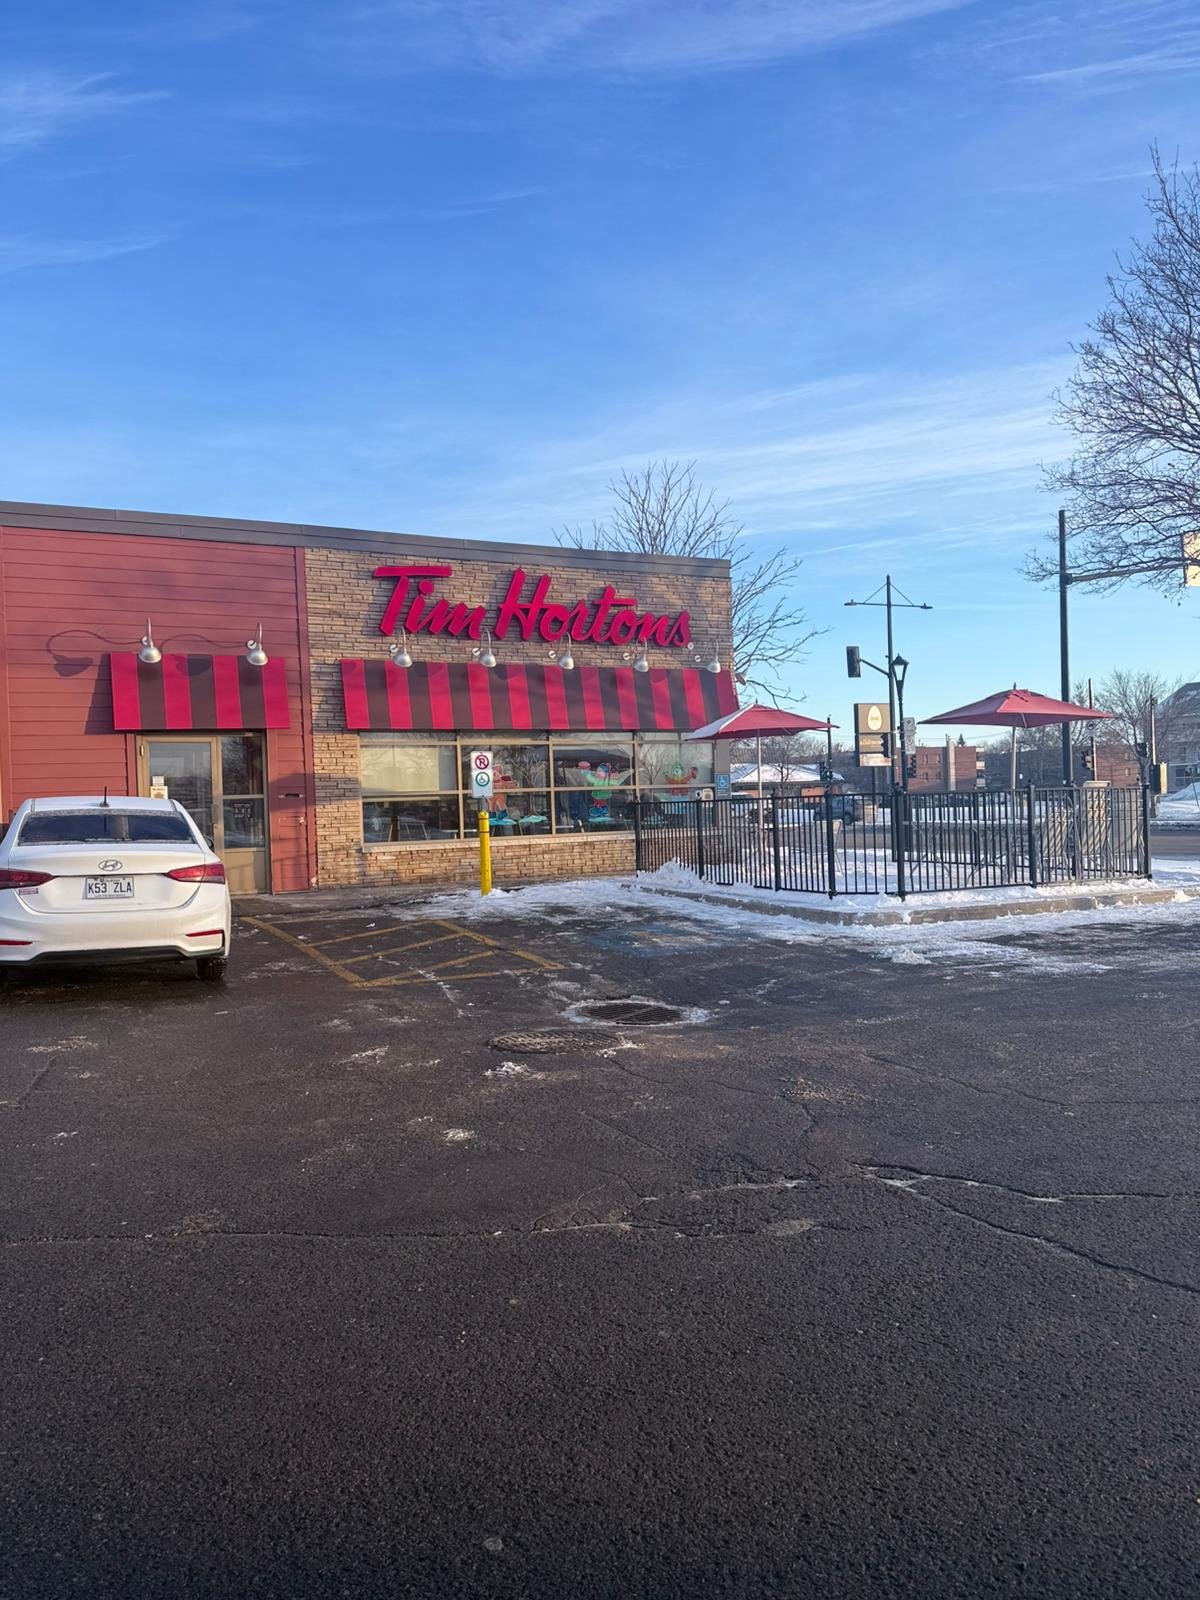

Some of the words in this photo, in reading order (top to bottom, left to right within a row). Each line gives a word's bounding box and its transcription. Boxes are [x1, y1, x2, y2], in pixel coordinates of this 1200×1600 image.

[373, 566, 486, 639] Tim
[494, 567, 692, 648] Hortons
[88, 882, 107, 894] K53
[113, 882, 132, 893] ZLA
